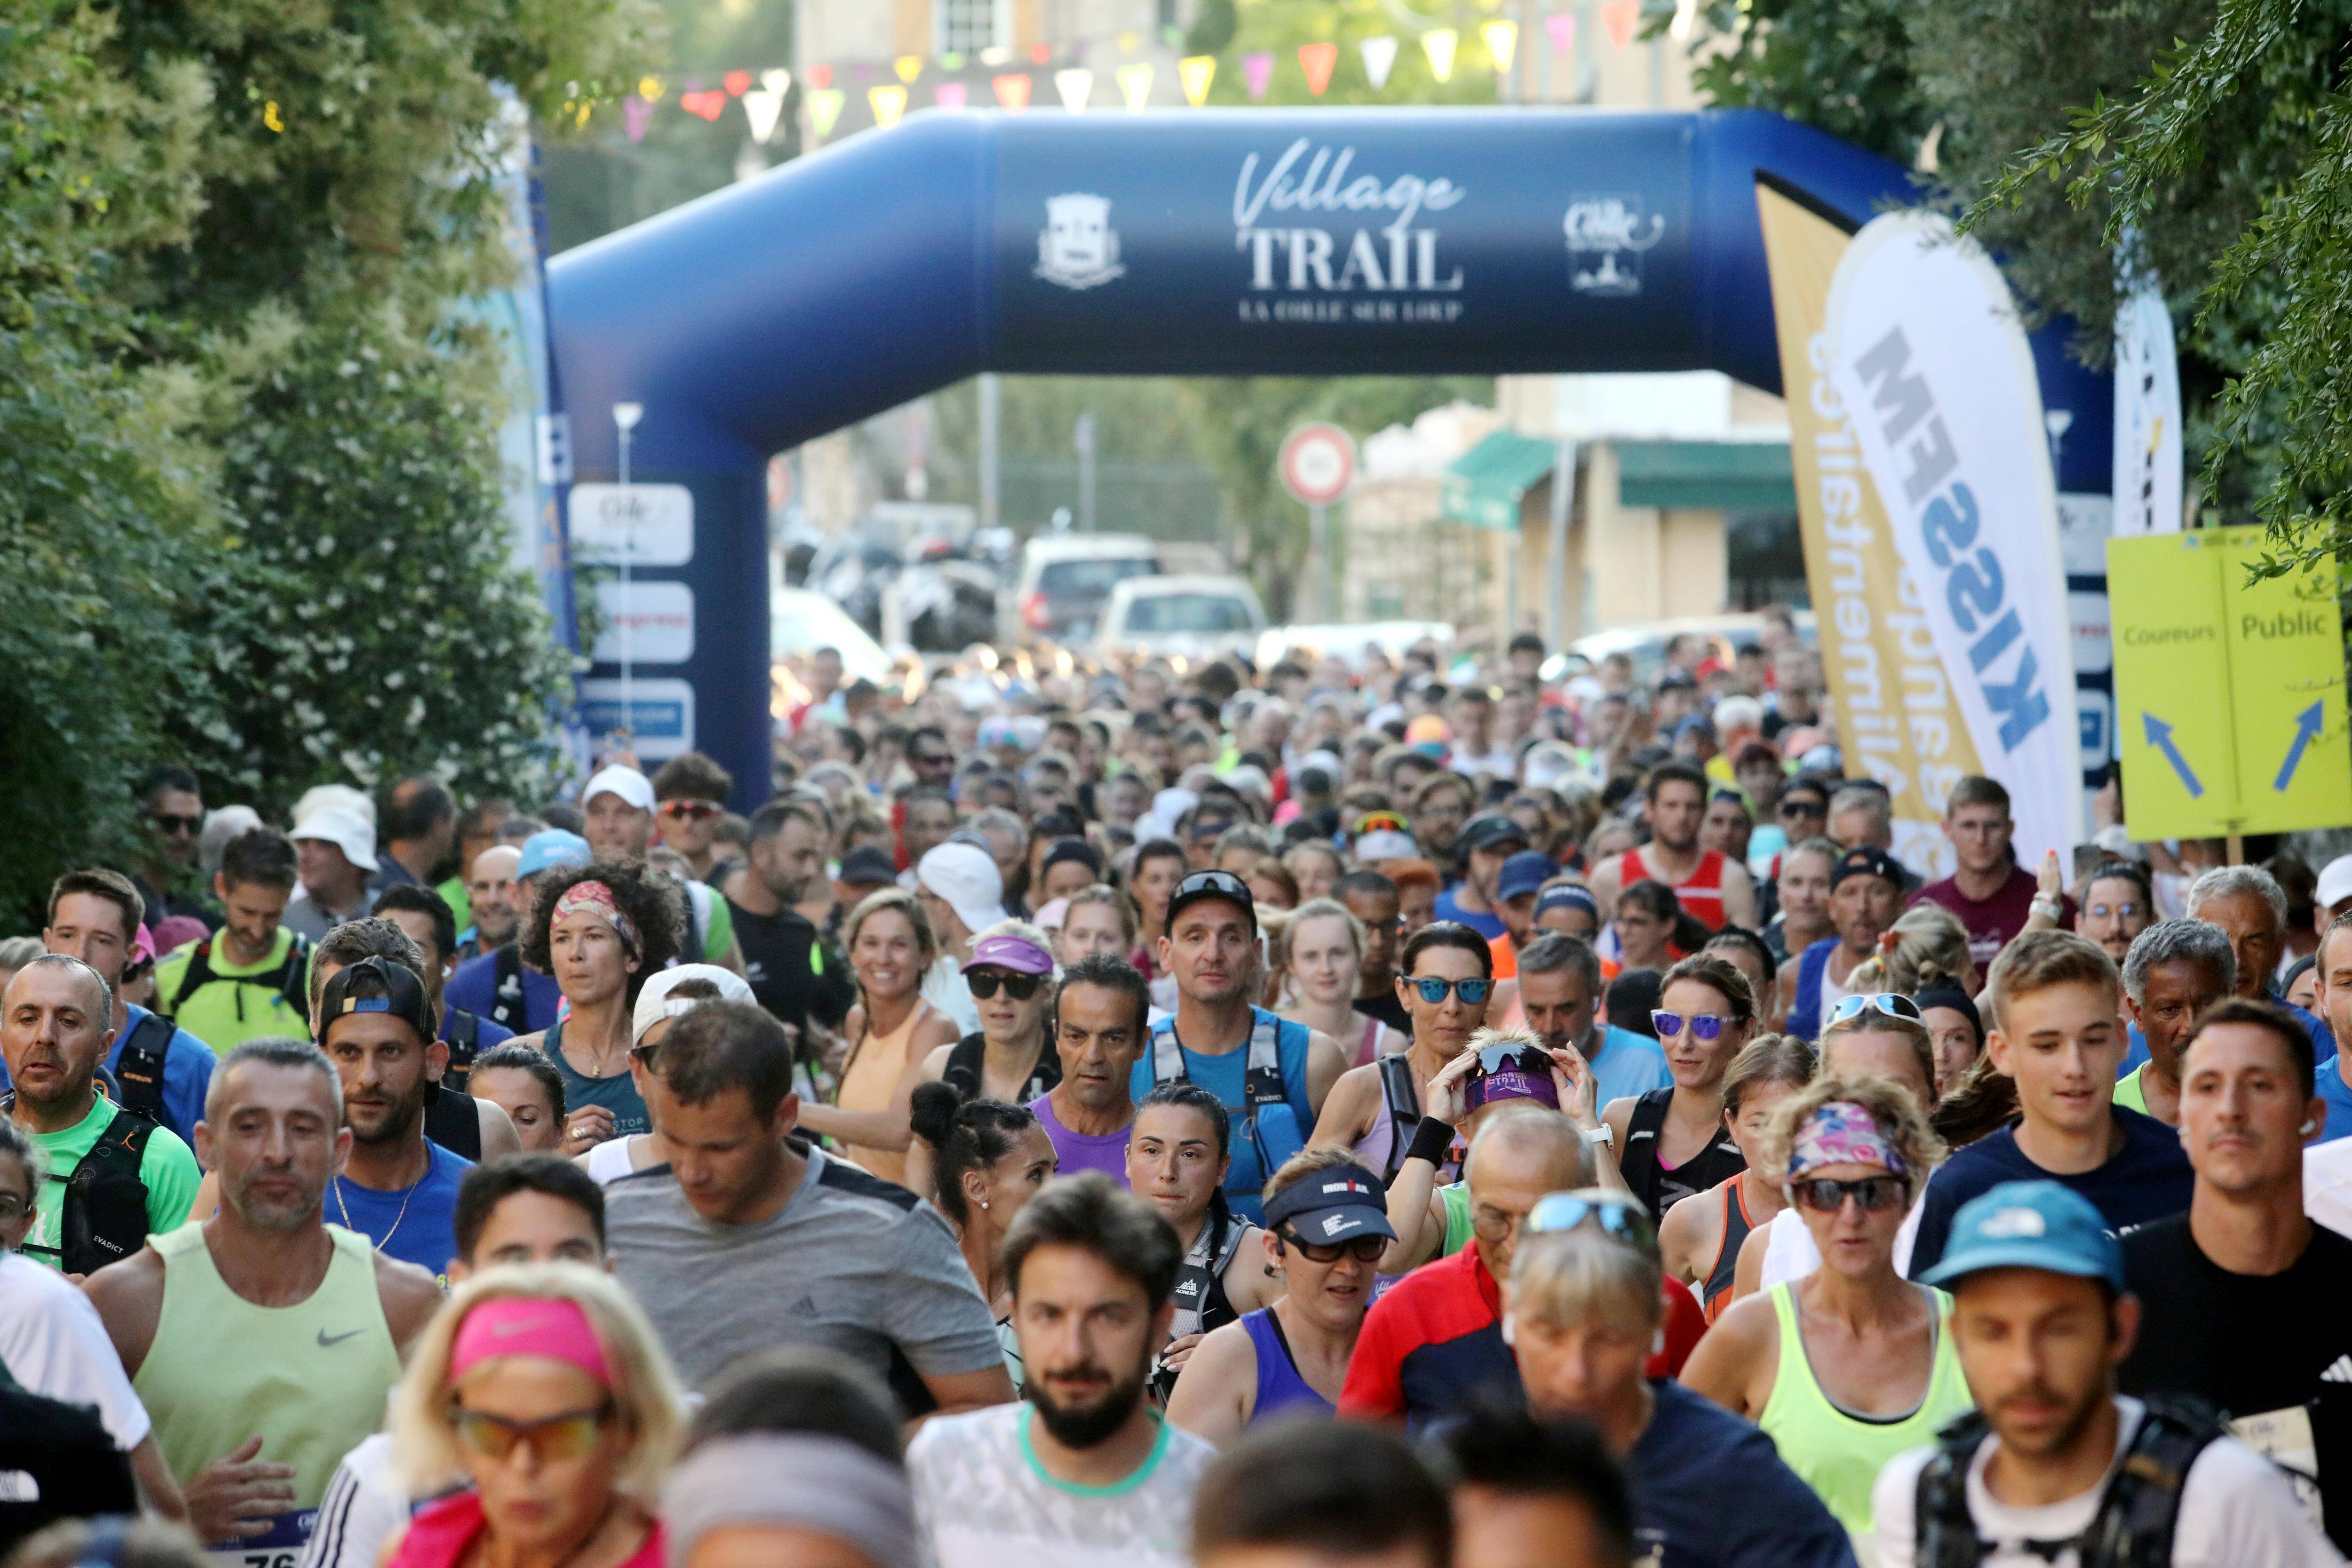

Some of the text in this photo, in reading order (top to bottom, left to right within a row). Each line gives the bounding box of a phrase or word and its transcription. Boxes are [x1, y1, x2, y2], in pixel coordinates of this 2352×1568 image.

[1233, 136, 1467, 229] Village
[1236, 226, 1464, 291] TRAIL
[2123, 624, 2215, 646] Coureurs
[2242, 611, 2326, 639] Public
[613, 1117, 644, 1129] STOP
[94, 1235, 124, 1253] EVADICT
